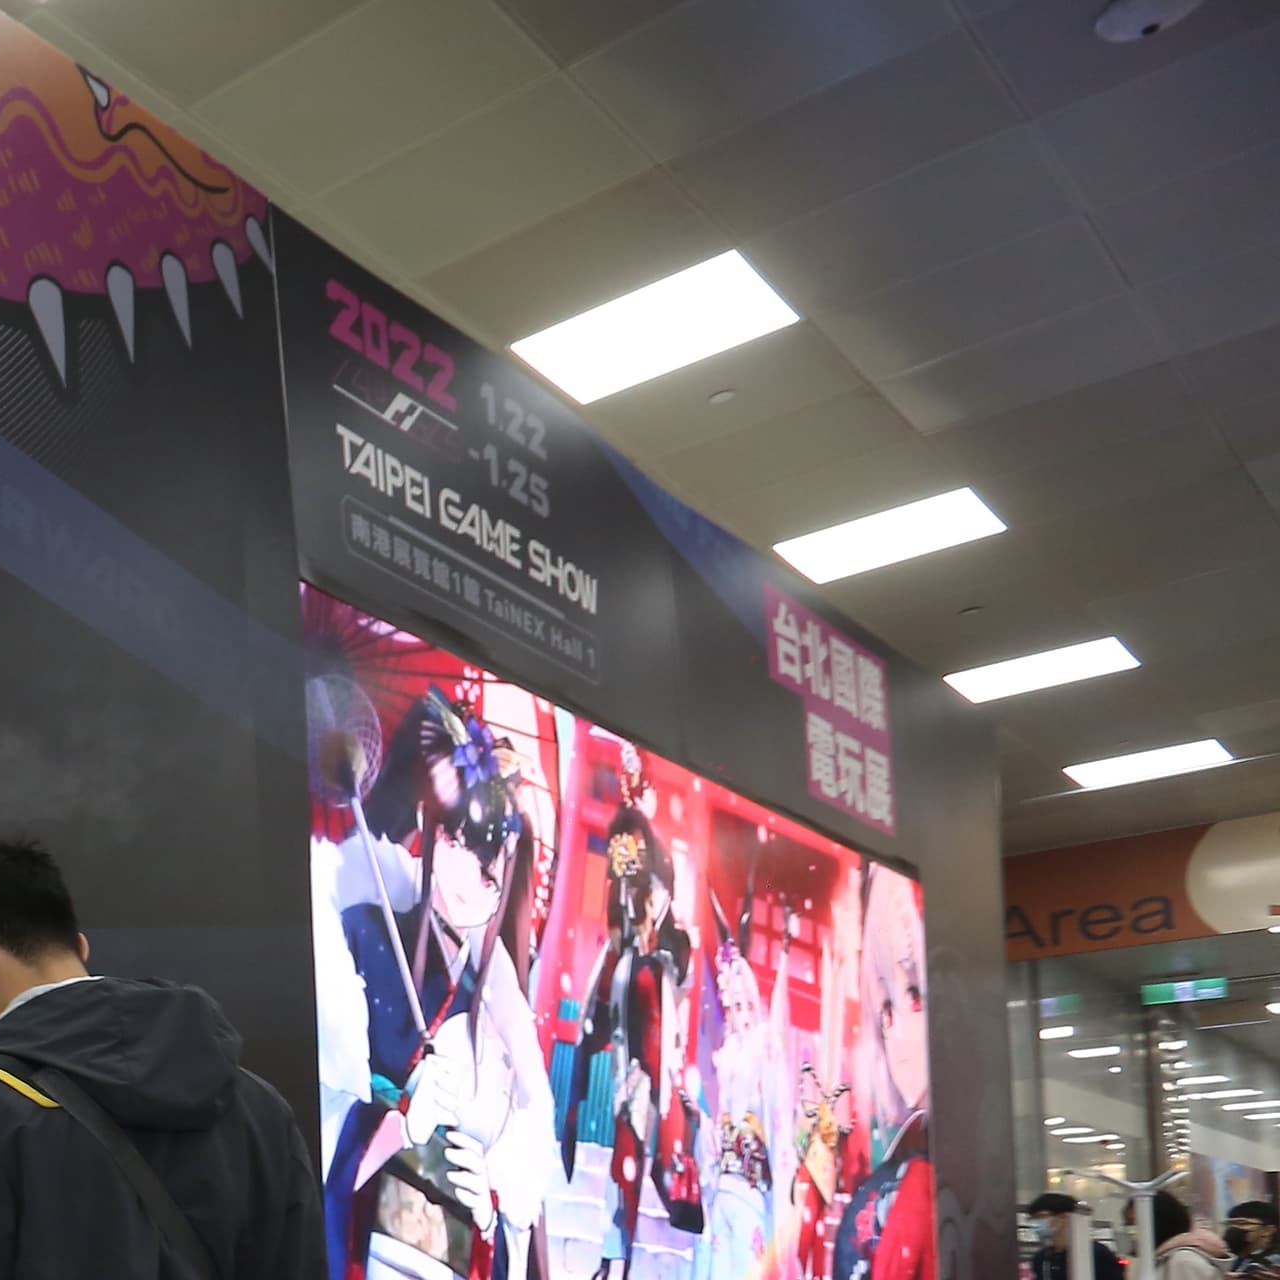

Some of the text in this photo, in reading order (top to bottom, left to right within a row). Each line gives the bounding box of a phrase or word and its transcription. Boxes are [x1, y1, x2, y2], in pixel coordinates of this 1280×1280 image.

[326, 279, 458, 413] 2022
[478, 381, 549, 460] 1.22
[336, 423, 598, 615] TAIPEI GAME SHOW
[484, 589, 545, 641] TaiNEX
[550, 626, 583, 661] Hall
[771, 601, 887, 731] 台北國際
[806, 712, 894, 828] 電玩展
[1006, 893, 1176, 949] Area
